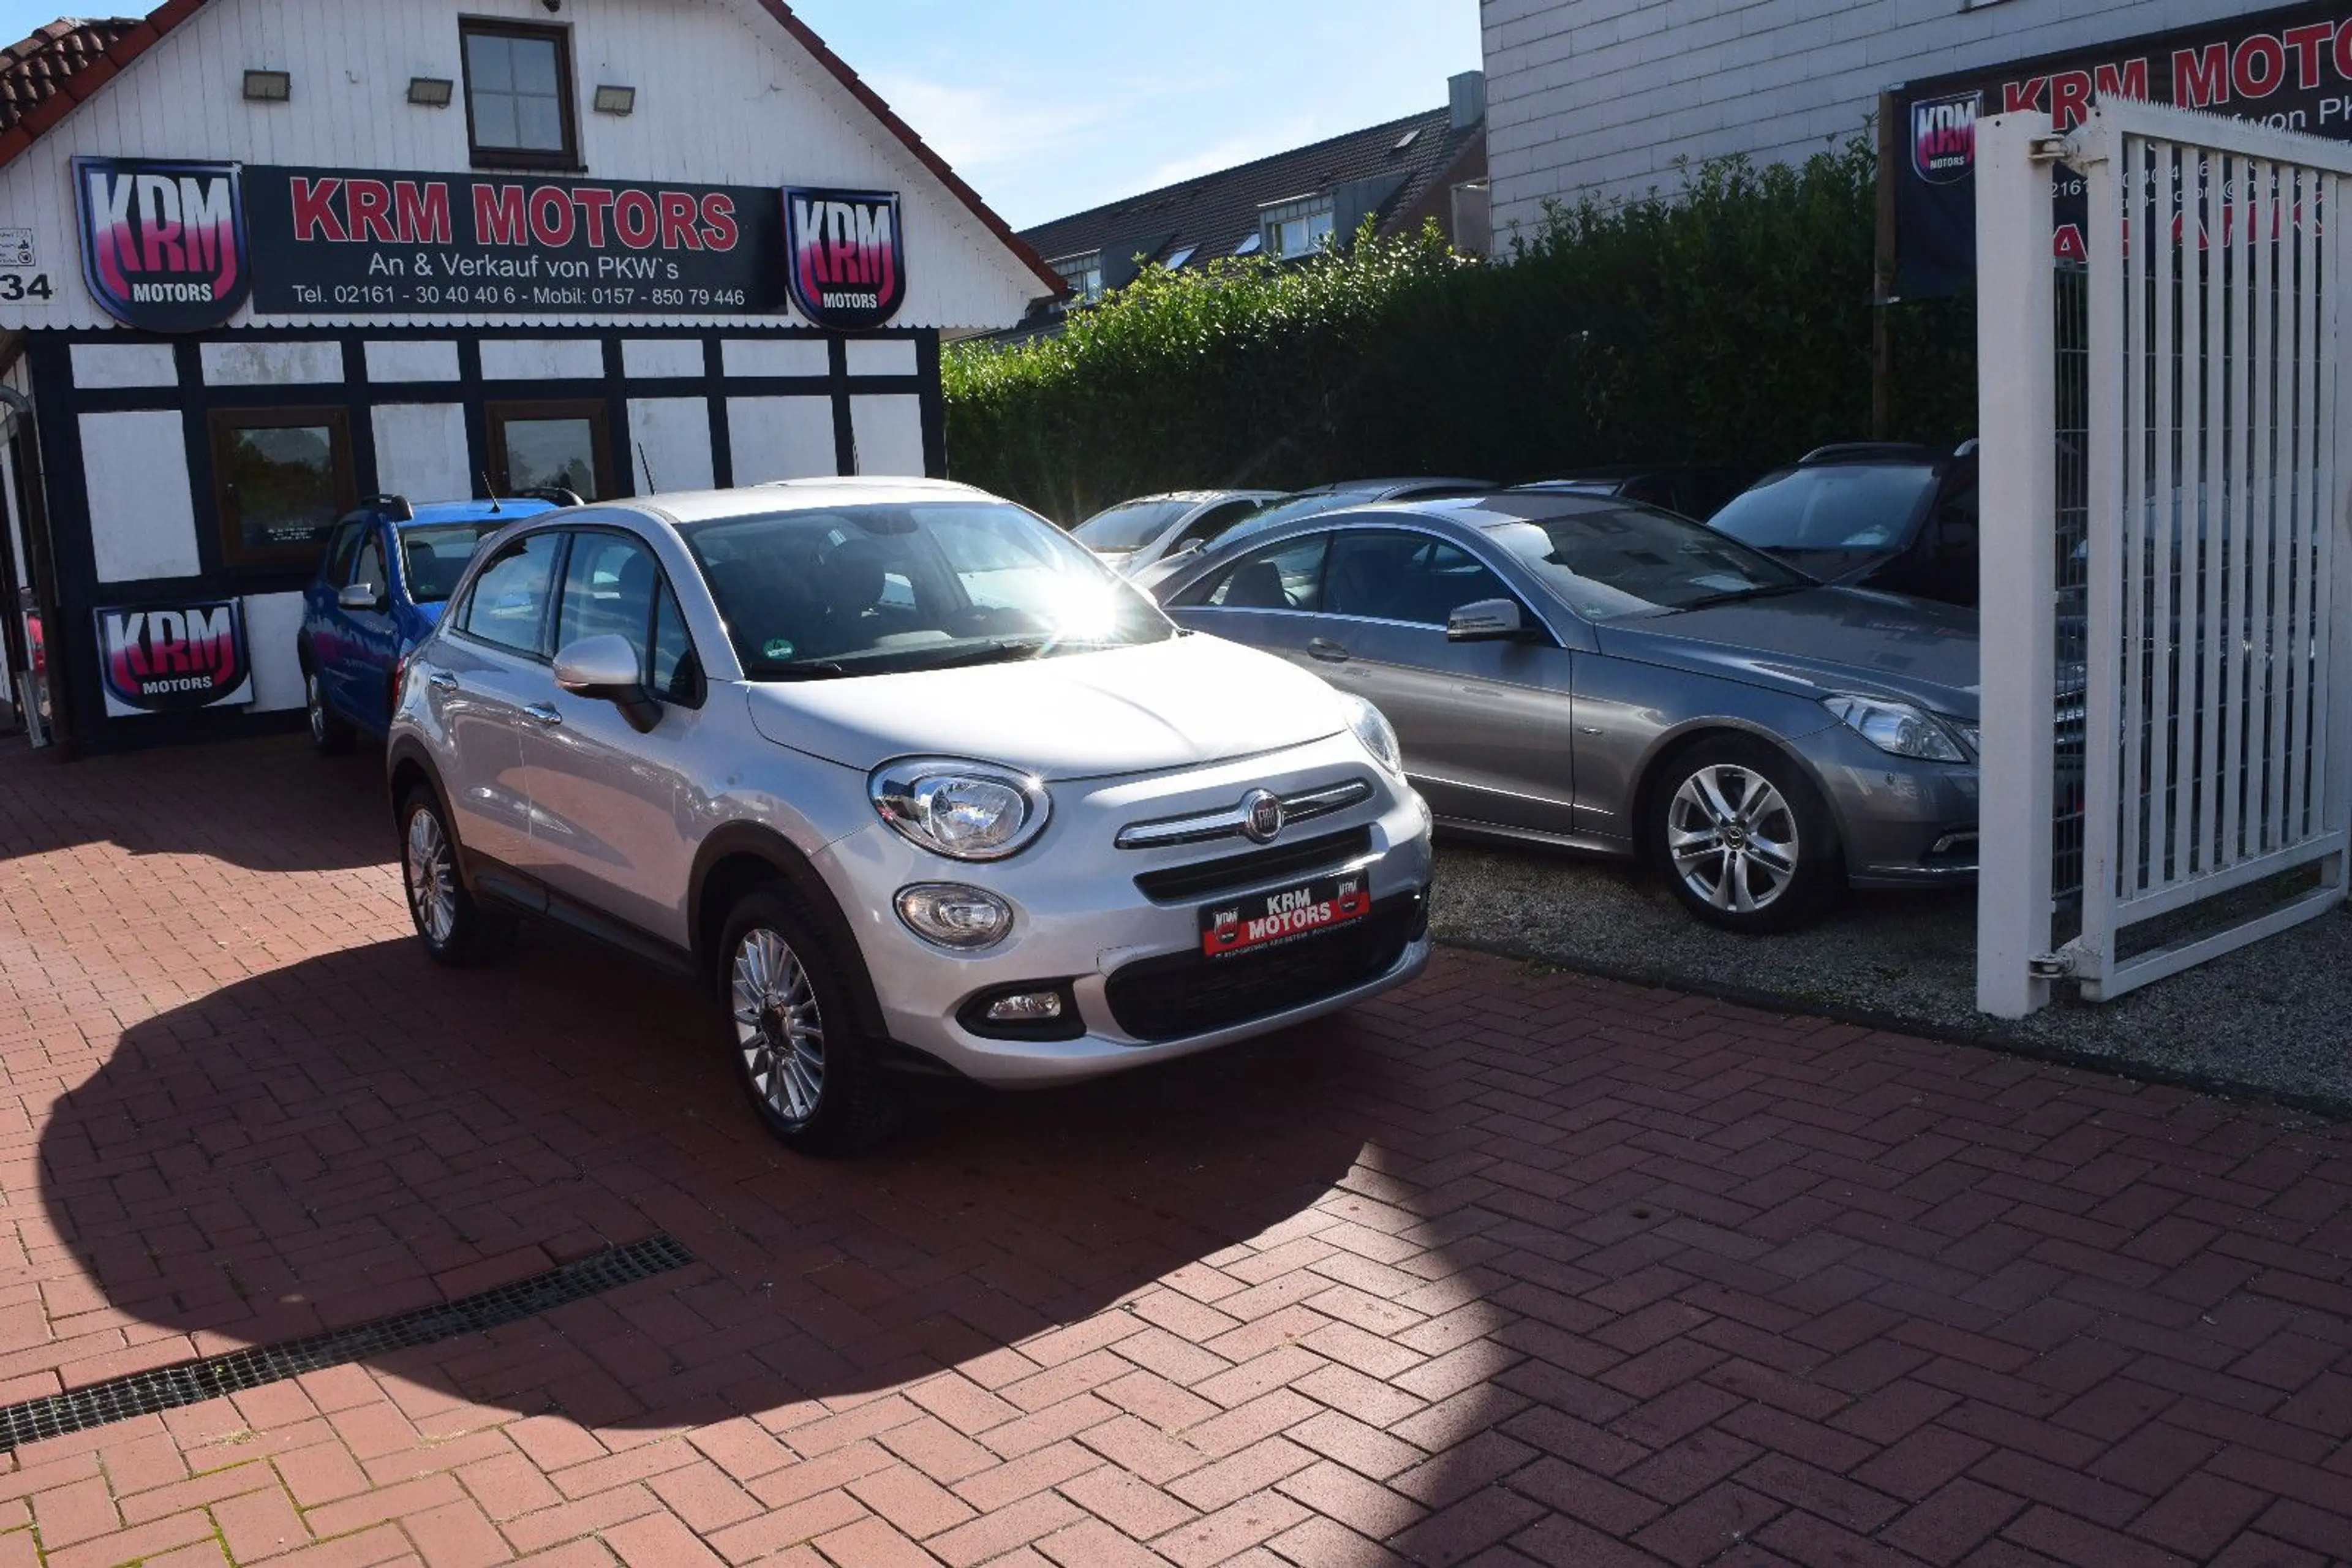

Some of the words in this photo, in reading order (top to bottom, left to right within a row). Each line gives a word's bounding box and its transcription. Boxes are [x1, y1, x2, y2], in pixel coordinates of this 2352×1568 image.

[2002, 57, 2148, 130] KRM
[1918, 100, 1976, 167] KRM
[1929, 156, 1965, 170] MOTORS
[290, 176, 453, 244] KRM
[472, 184, 739, 252] MOTORS
[90, 173, 236, 300] KRM
[369, 252, 404, 276] An
[414, 252, 433, 276] &
[440, 252, 540, 277] Verkauf
[546, 260, 589, 277] von
[795, 200, 895, 307] KRM
[132, 283, 213, 303] MOTORS
[292, 285, 328, 303] Tel.
[334, 285, 394, 303] 02161
[415, 286, 440, 304] 30
[445, 286, 469, 304] 40
[475, 286, 499, 304] 40
[503, 286, 516, 304] 6
[534, 287, 586, 305] Mobil:
[592, 288, 635, 305] 0157
[652, 288, 684, 306] 850
[689, 289, 710, 306] 79
[714, 289, 745, 306] 446
[823, 292, 877, 309] MOTORS
[107, 607, 235, 695] KRM
[143, 676, 213, 695] MOTORS
[1267, 888, 1311, 915] KRM
[1248, 902, 1332, 940] MOTORS
